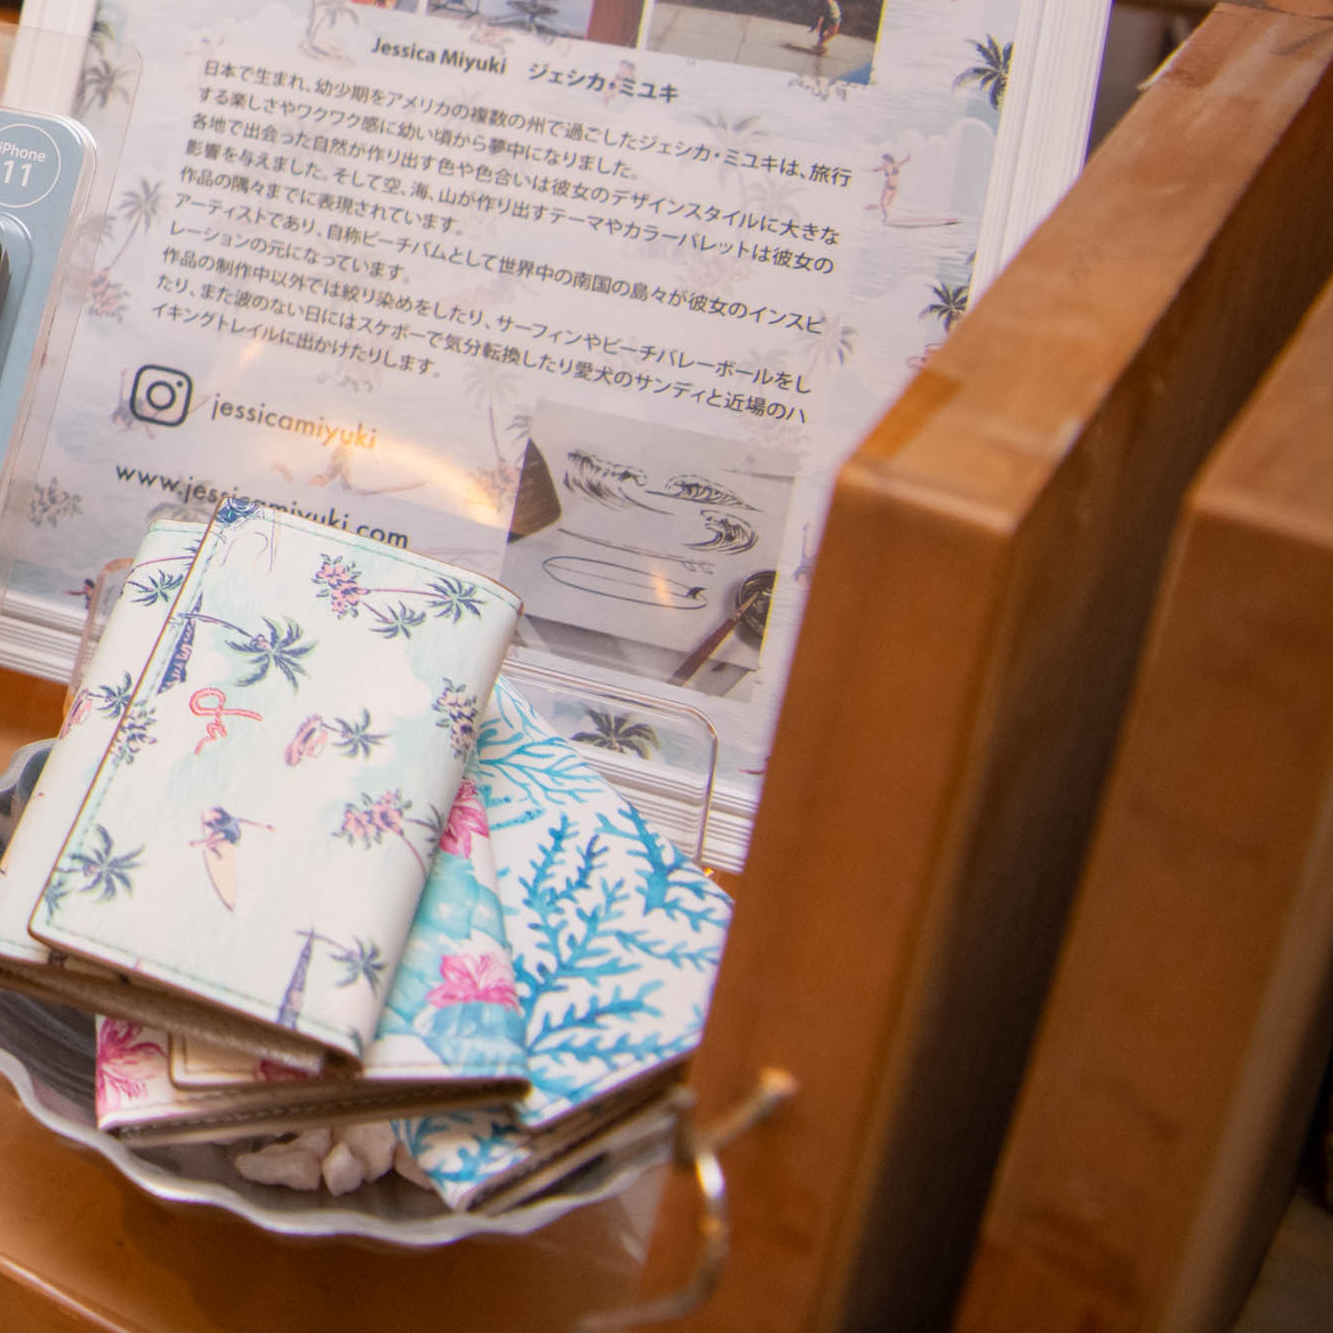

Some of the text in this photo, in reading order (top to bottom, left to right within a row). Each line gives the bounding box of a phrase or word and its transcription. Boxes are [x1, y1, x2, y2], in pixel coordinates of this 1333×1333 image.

[371, 37, 679, 103] Jessica Miyuki ジェシカ・ミユキ
[4, 160, 32, 187] 11
[212, 393, 377, 450] jessicamiyuki
